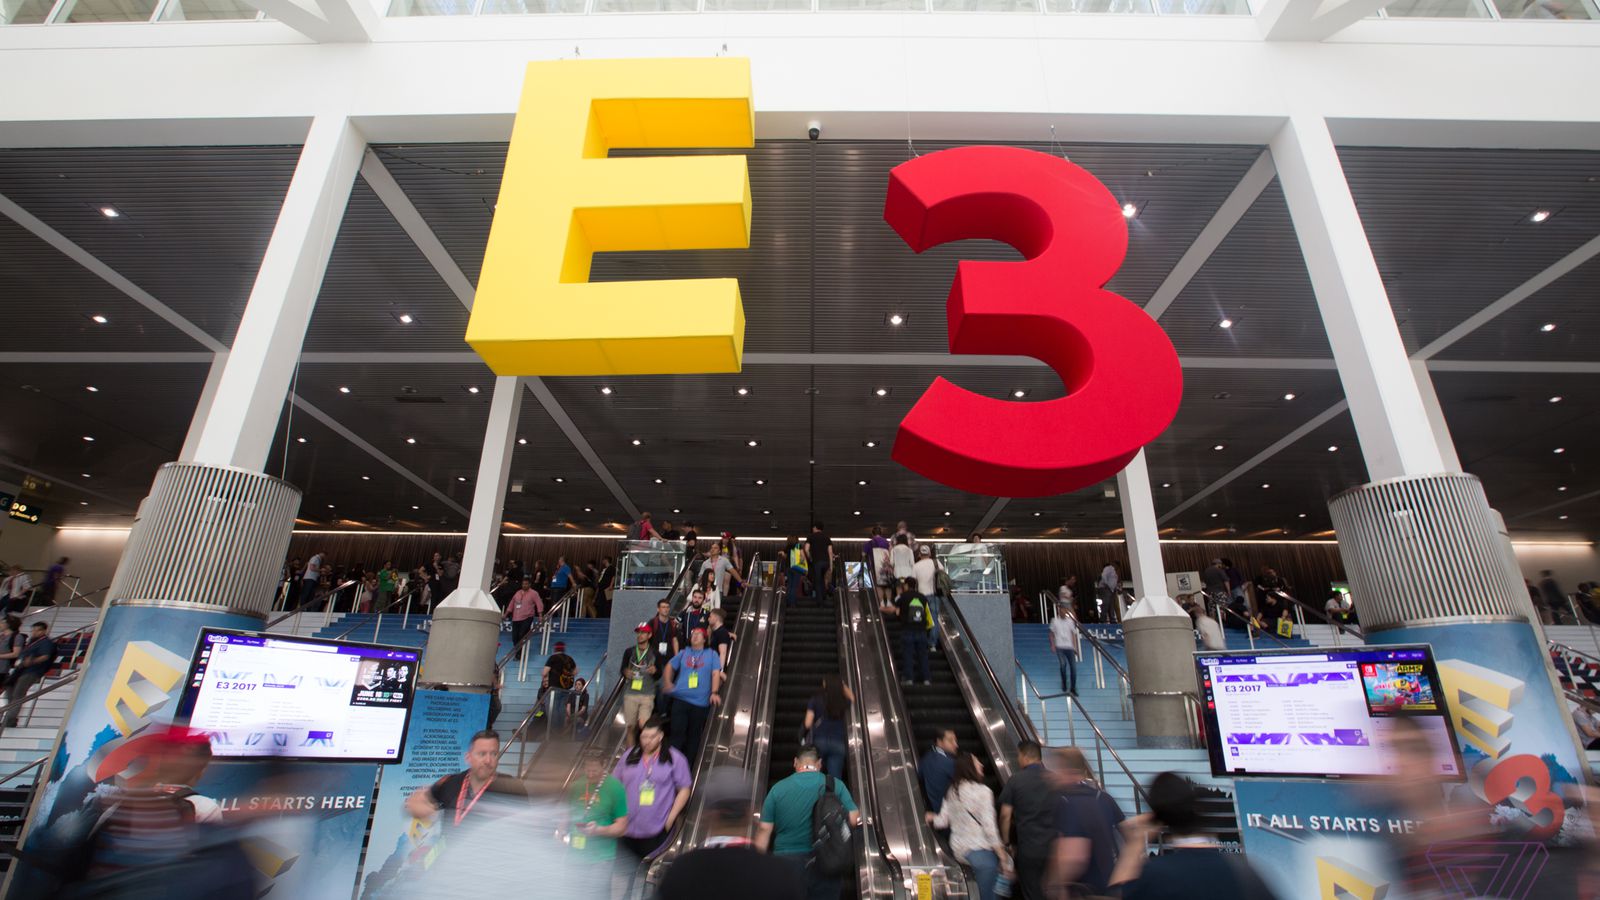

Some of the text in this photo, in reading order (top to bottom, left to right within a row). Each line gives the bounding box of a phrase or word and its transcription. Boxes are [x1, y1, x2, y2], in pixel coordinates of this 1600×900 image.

[216, 681, 229, 690] E3
[232, 682, 257, 691] 2017
[1224, 685, 1238, 693] E3
[1239, 684, 1261, 693] 2017
[248, 796, 315, 810] STARTS
[320, 795, 366, 809] HERE
[1246, 813, 1262, 827] IT
[1270, 814, 1304, 829] ALL
[1309, 815, 1381, 833] STARTS
